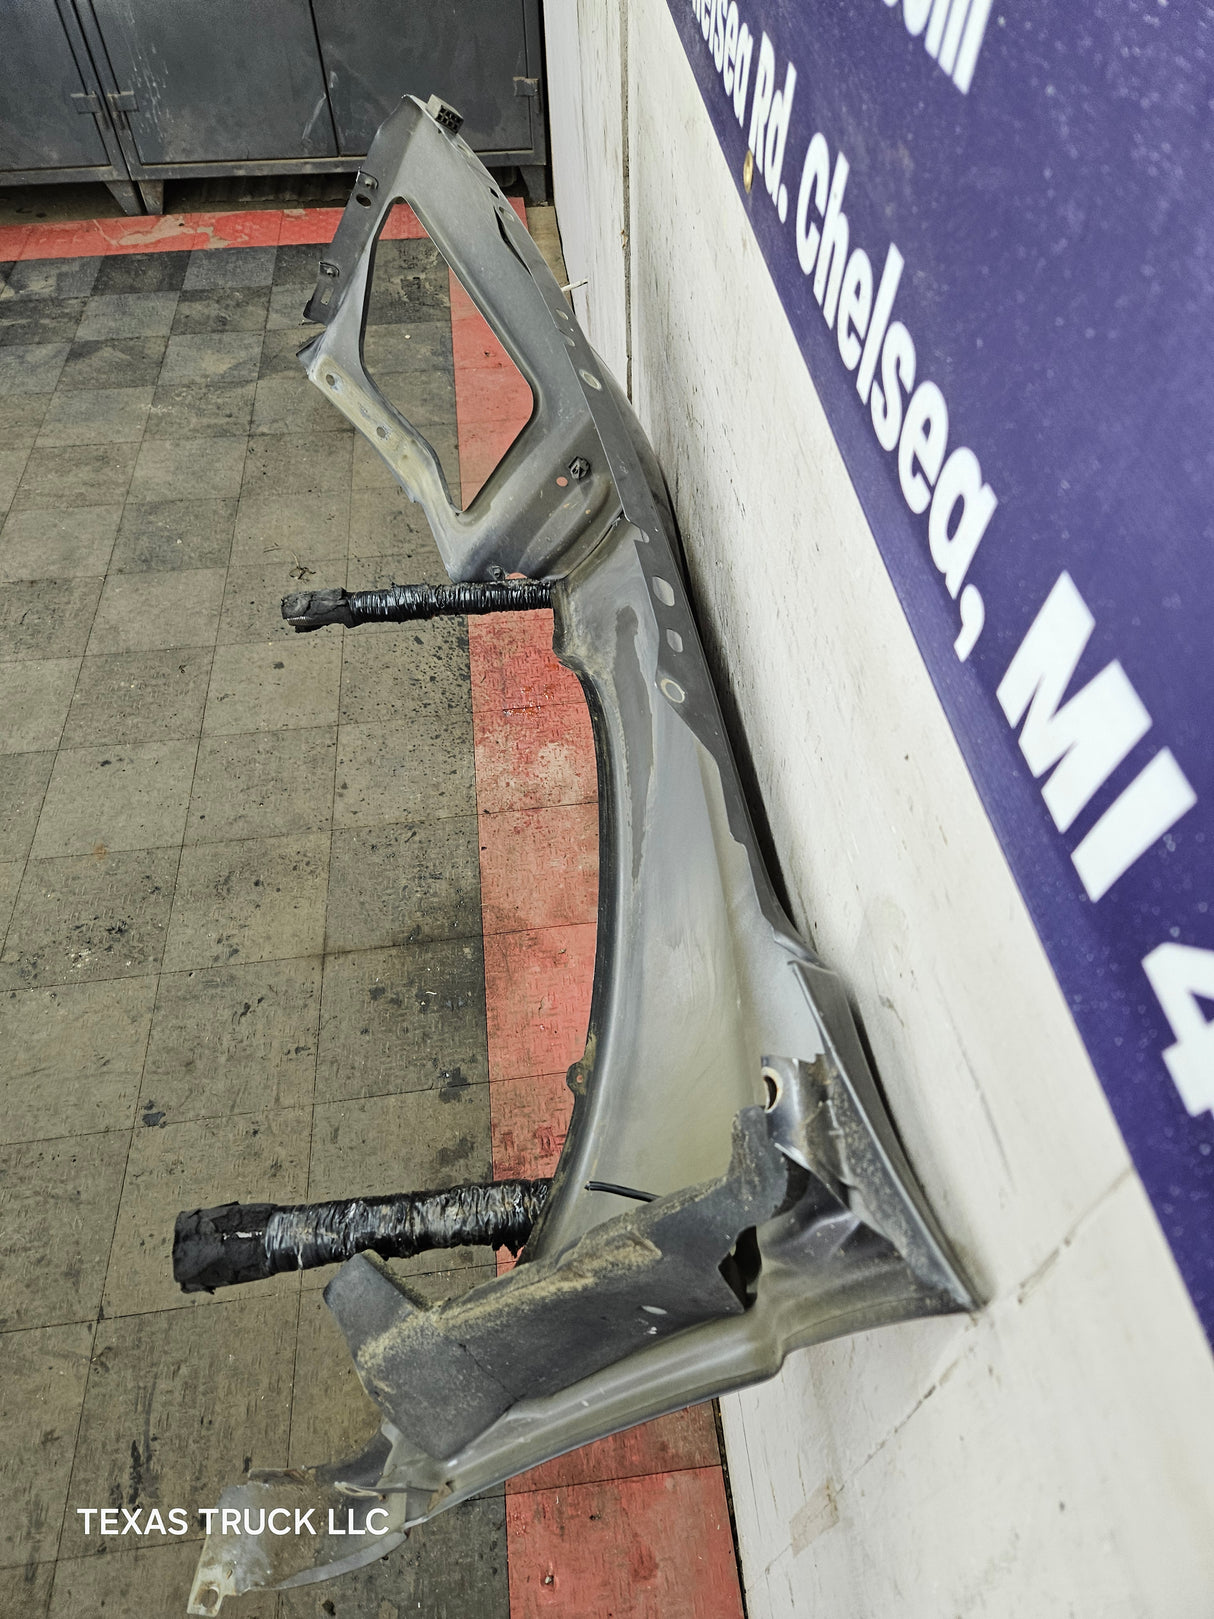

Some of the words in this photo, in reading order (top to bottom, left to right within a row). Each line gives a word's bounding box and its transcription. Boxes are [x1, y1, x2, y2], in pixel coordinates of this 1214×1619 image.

[747, 30, 797, 224] Rd.
[796, 132, 998, 662] Chelsea,
[996, 569, 1197, 903] MI
